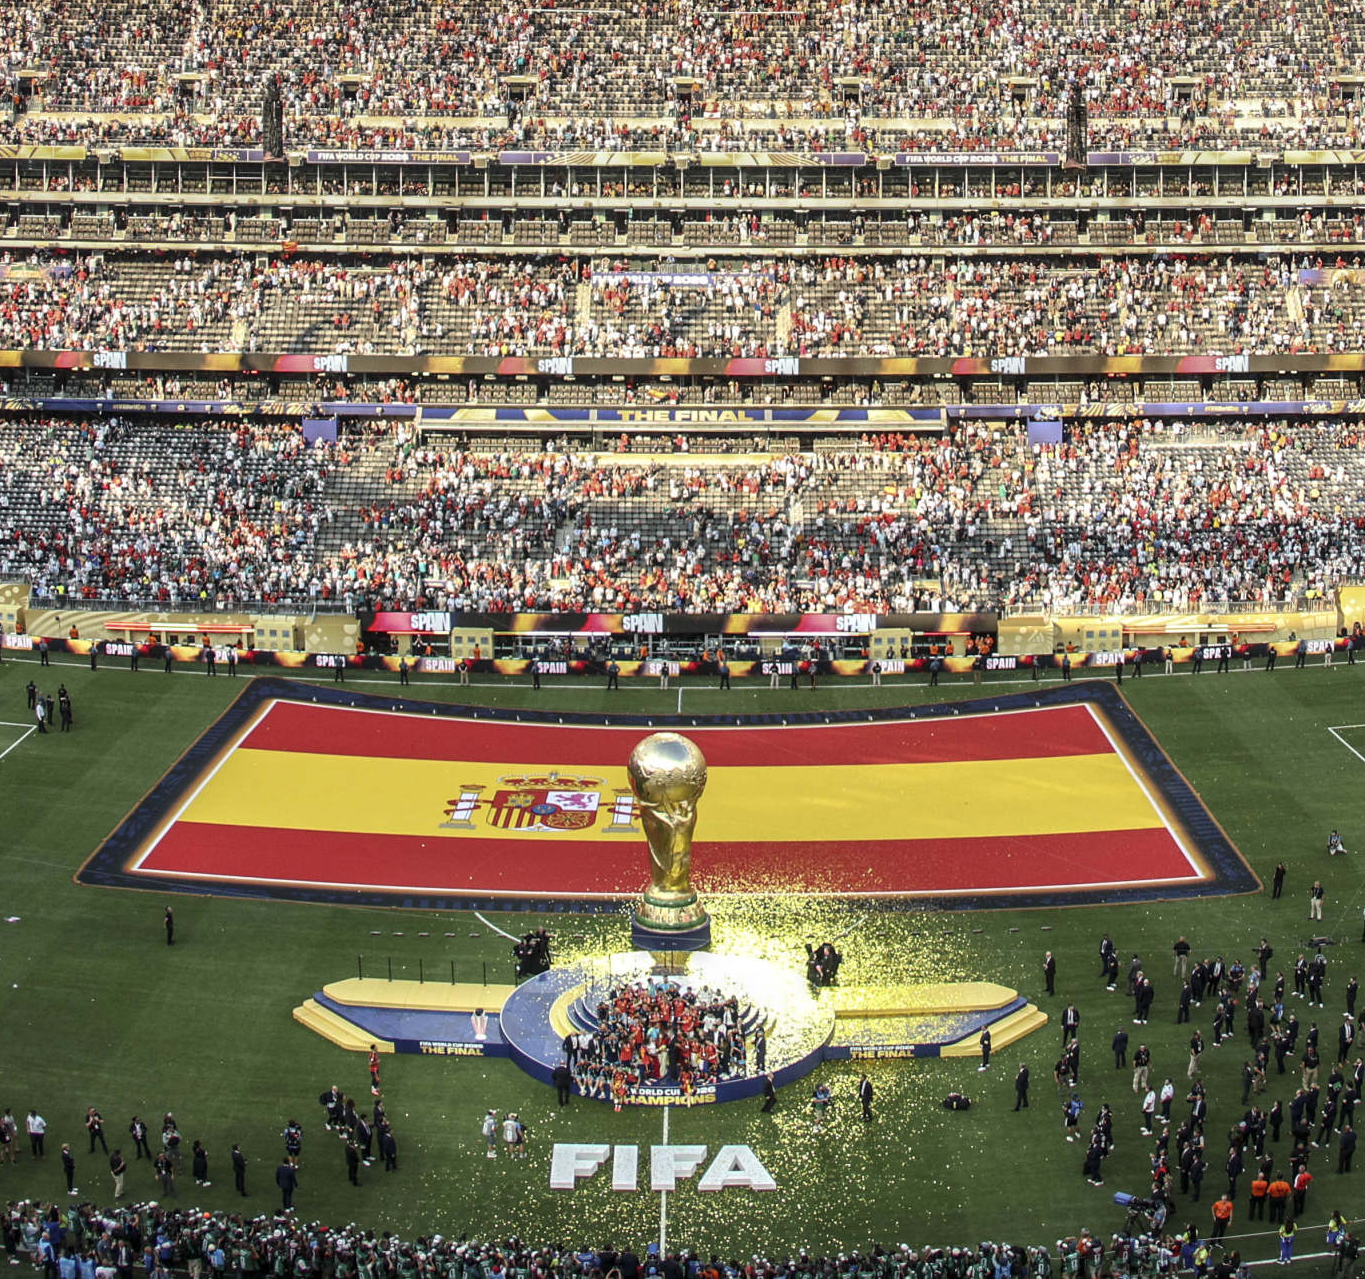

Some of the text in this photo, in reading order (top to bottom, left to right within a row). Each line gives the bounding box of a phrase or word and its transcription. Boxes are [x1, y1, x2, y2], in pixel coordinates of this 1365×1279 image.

[317, 153, 335, 161] FIFA
[336, 153, 364, 161] WORLD
[365, 153, 381, 162] CUP
[412, 152, 431, 162] THE
[432, 152, 459, 162] FINAL
[906, 155, 923, 163] FIFA
[924, 155, 952, 163] WORLD
[953, 155, 969, 164] CUP
[1000, 154, 1019, 164] THE
[1020, 154, 1048, 164] FINAL
[93, 351, 127, 369] SPAIN
[314, 354, 348, 373] SPAIN
[538, 356, 573, 375] SPAIN
[764, 357, 799, 375] SPAIN
[991, 357, 1026, 375] SPAIN
[1216, 355, 1249, 373] SPAIN
[617, 410, 753, 422] THE FINAL
[411, 612, 451, 633] SPAIN
[623, 613, 663, 634] SPAIN
[837, 613, 877, 633] SPAIN
[6, 635, 33, 649] SPAIN
[426, 659, 455, 672] SPAIN
[537, 661, 567, 674] SPAIN
[986, 657, 1016, 670] SPAIN
[420, 1046, 484, 1057] THE FINAL
[851, 1049, 915, 1059] THE FINAL
[549, 1143, 777, 1192] FIFA
